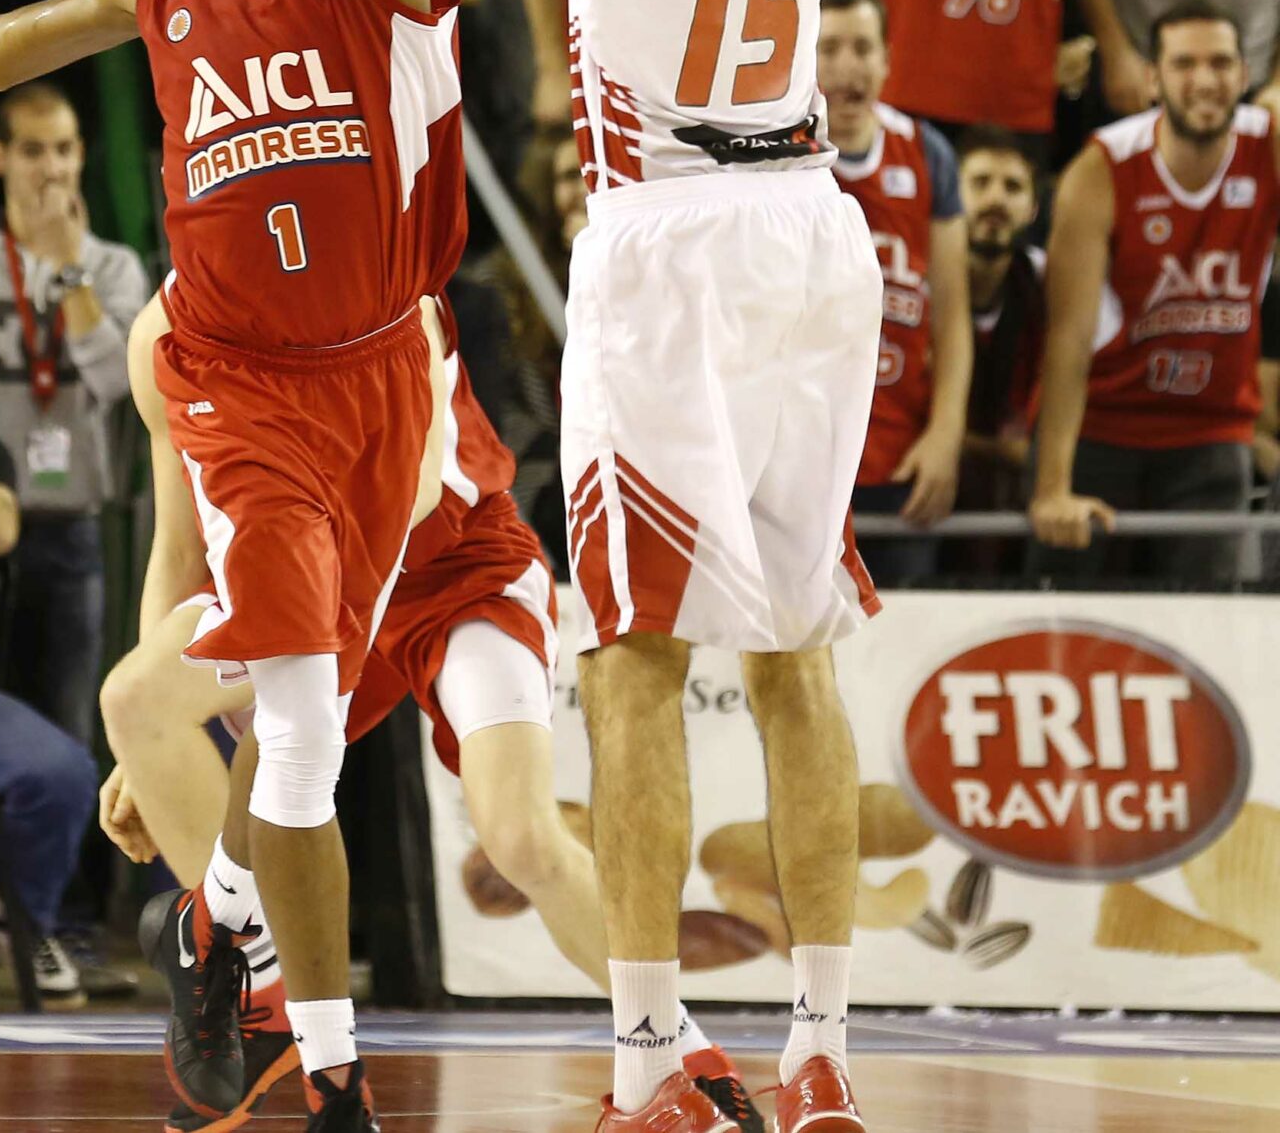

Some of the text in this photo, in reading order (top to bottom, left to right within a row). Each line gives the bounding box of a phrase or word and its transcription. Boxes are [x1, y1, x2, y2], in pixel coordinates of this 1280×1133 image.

[187, 120, 371, 199] MANRESA
[267, 203, 307, 271] 1
[938, 671, 1193, 772] FRIT
[951, 778, 1191, 832] RAVICH
[616, 1034, 677, 1050] MERCURY
